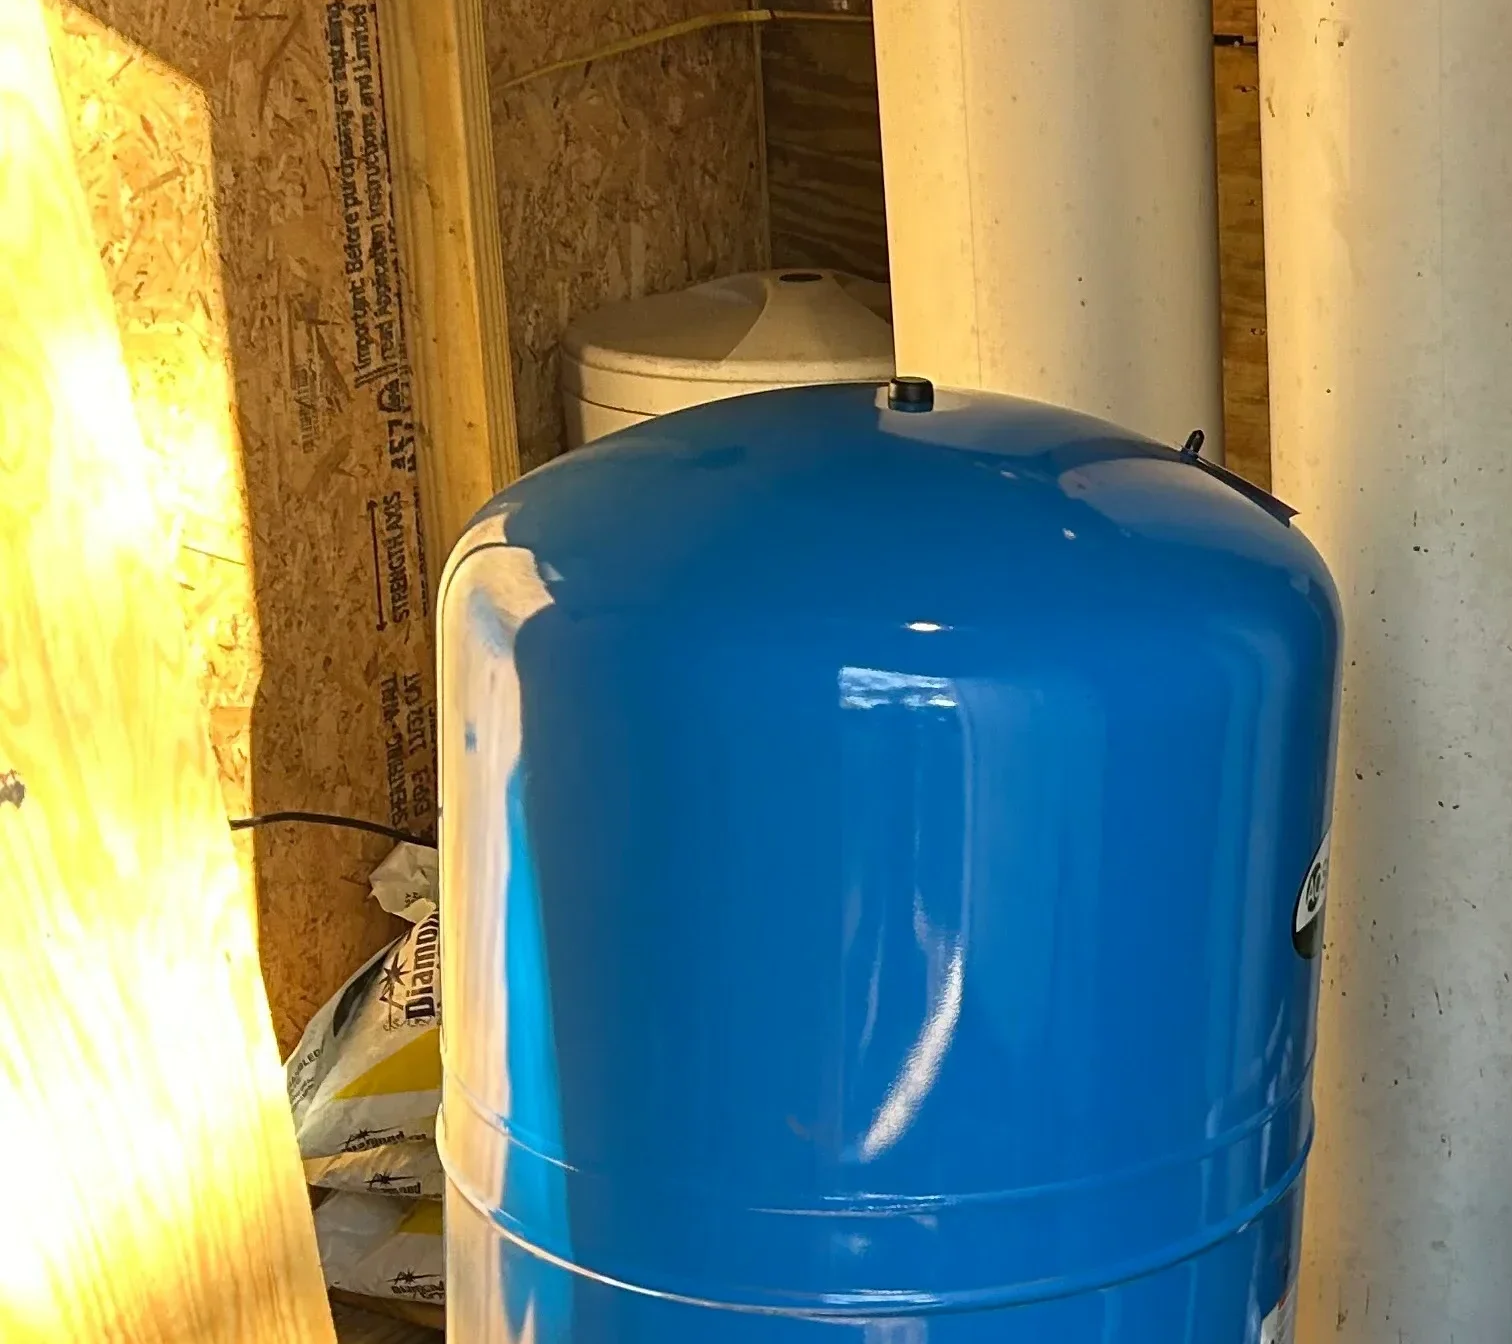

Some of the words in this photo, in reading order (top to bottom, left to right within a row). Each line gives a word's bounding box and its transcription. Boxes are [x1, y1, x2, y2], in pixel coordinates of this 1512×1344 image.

[354, 75, 374, 107] and
[343, 211, 364, 275] Before
[383, 490, 402, 532] AXIS
[383, 534, 410, 624] STRENGTH
[404, 672, 423, 704] CAT
